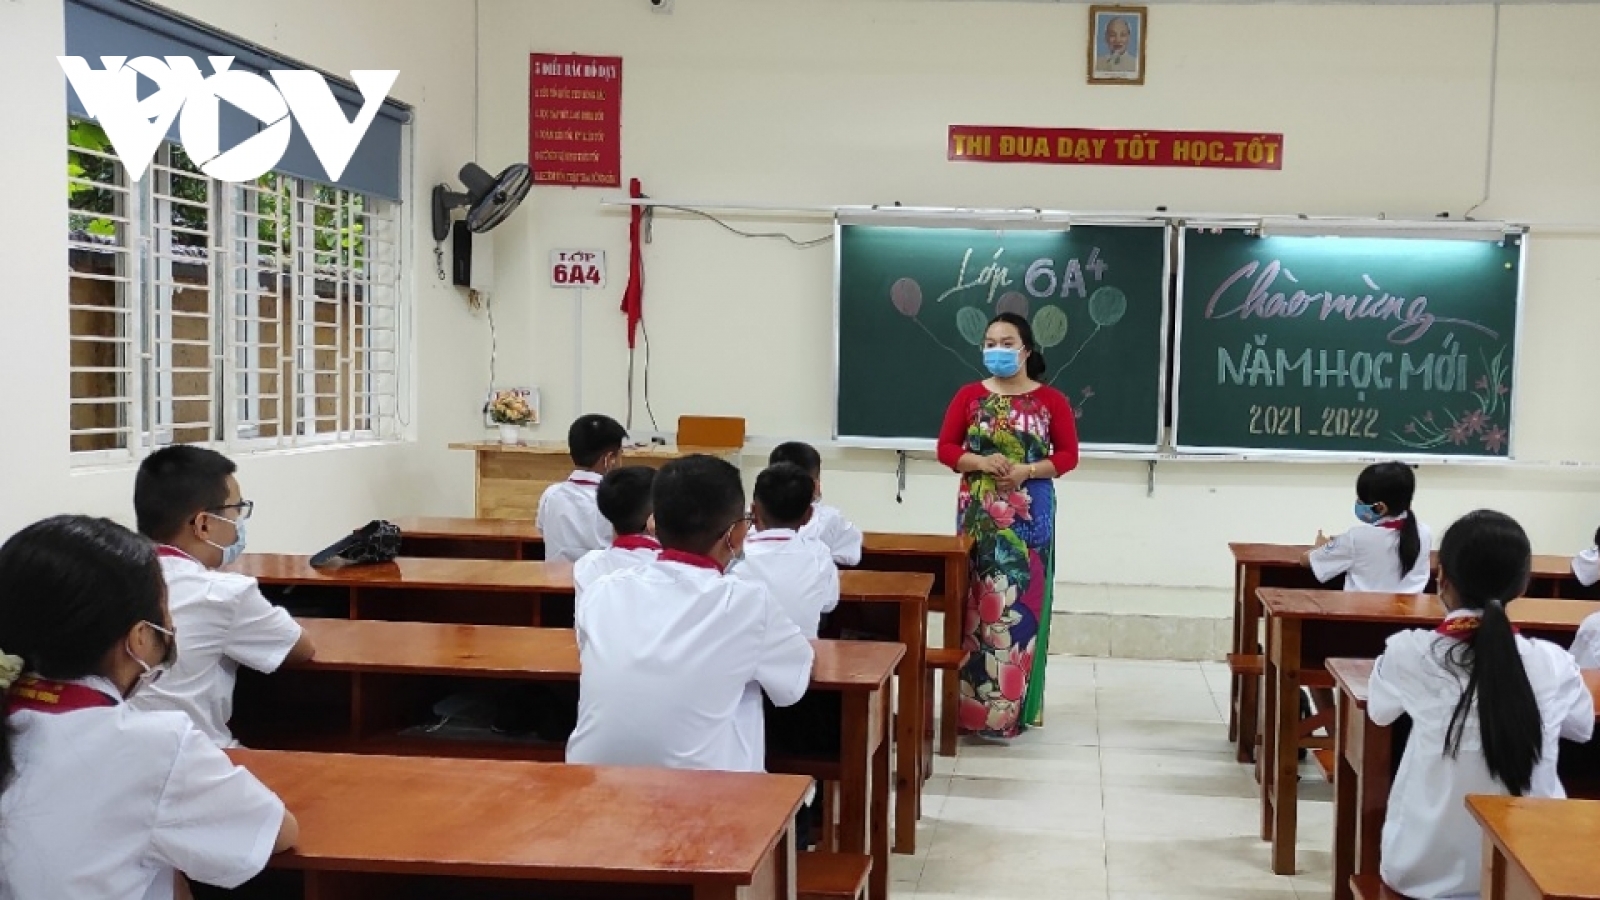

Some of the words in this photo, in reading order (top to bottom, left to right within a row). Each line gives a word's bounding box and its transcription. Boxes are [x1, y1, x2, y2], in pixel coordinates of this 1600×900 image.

[953, 134, 991, 156] THI
[999, 135, 1050, 157] ĐUA
[1057, 136, 1106, 161] DẠY
[1114, 133, 1160, 161] TỐT
[554, 264, 601, 285] 6A4
[937, 247, 1013, 303] Lớp
[1204, 259, 1322, 320] Chào
[1217, 334, 1312, 388] NĂM
[1314, 350, 1394, 402] HỌC
[1400, 332, 1468, 392] MỚI
